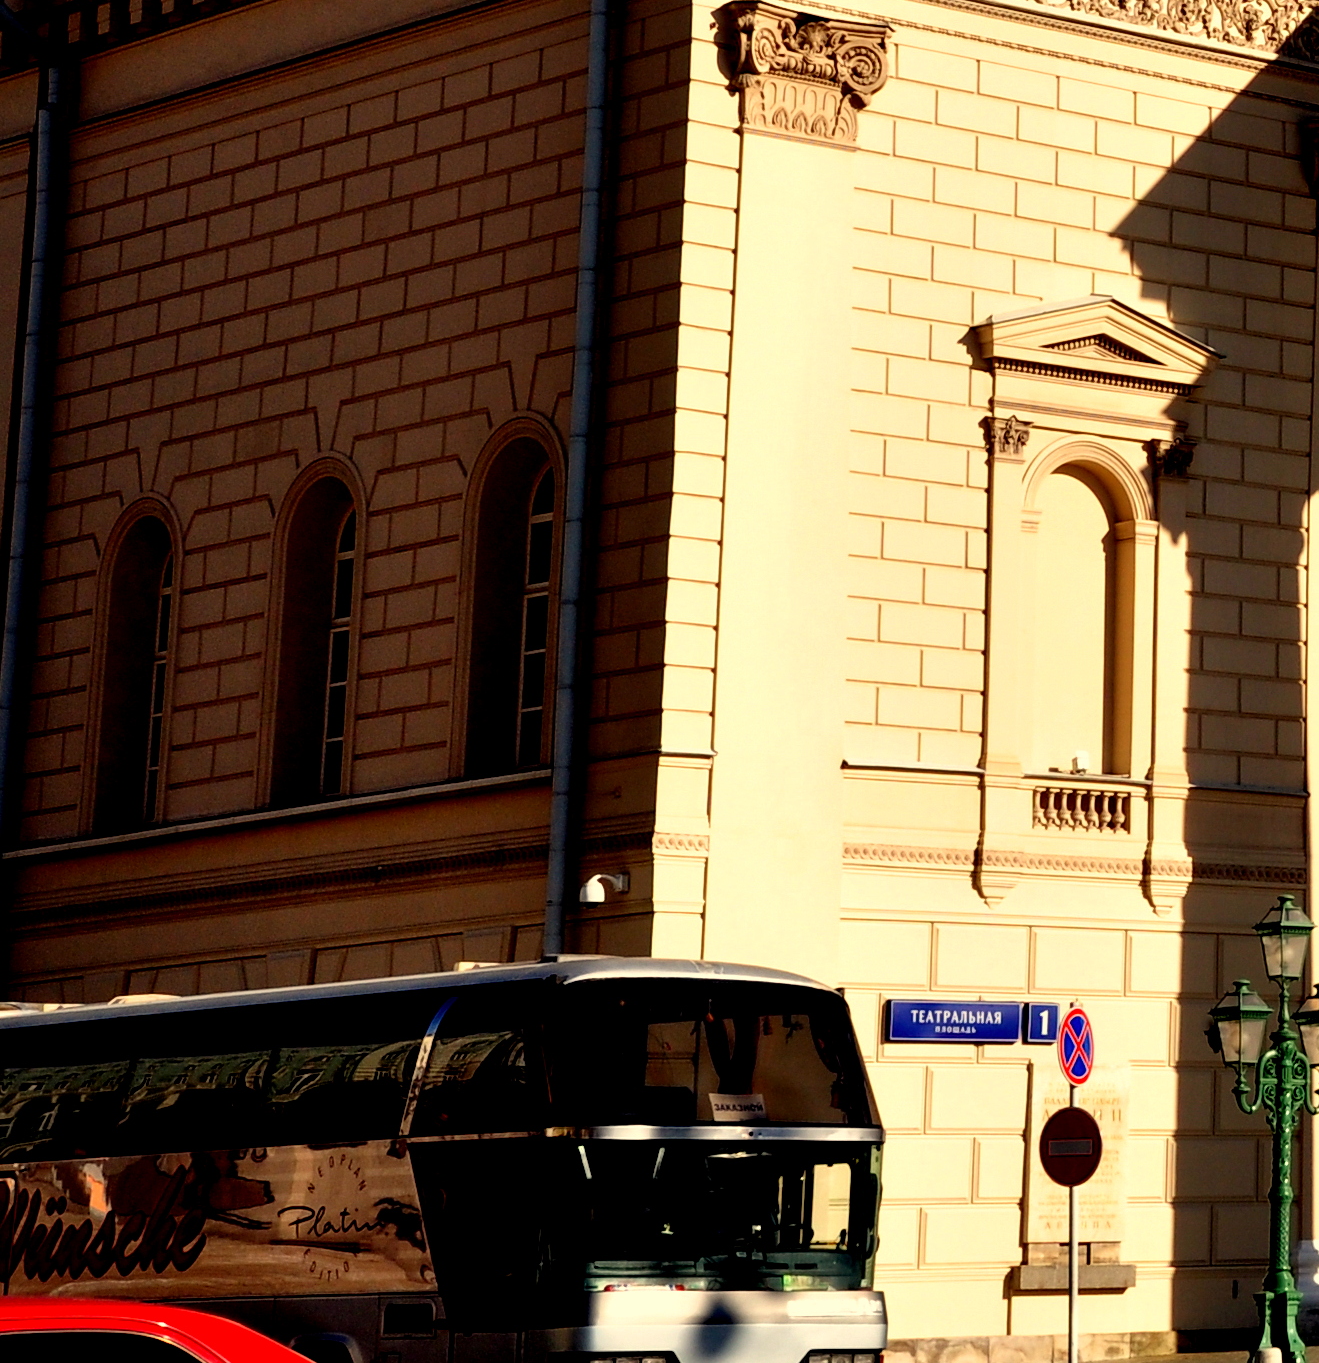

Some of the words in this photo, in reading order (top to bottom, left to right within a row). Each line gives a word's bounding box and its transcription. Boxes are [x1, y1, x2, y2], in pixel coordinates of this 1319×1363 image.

[910, 1009, 1002, 1025] ТЕАТРАЛЬНАЯ
[1039, 1009, 1050, 1036] 1
[934, 1025, 977, 1034] ПЛОЩАДЬ
[713, 1102, 764, 1112] ЗАКАЗНОЙ
[307, 1153, 367, 1194] NEOPLAN
